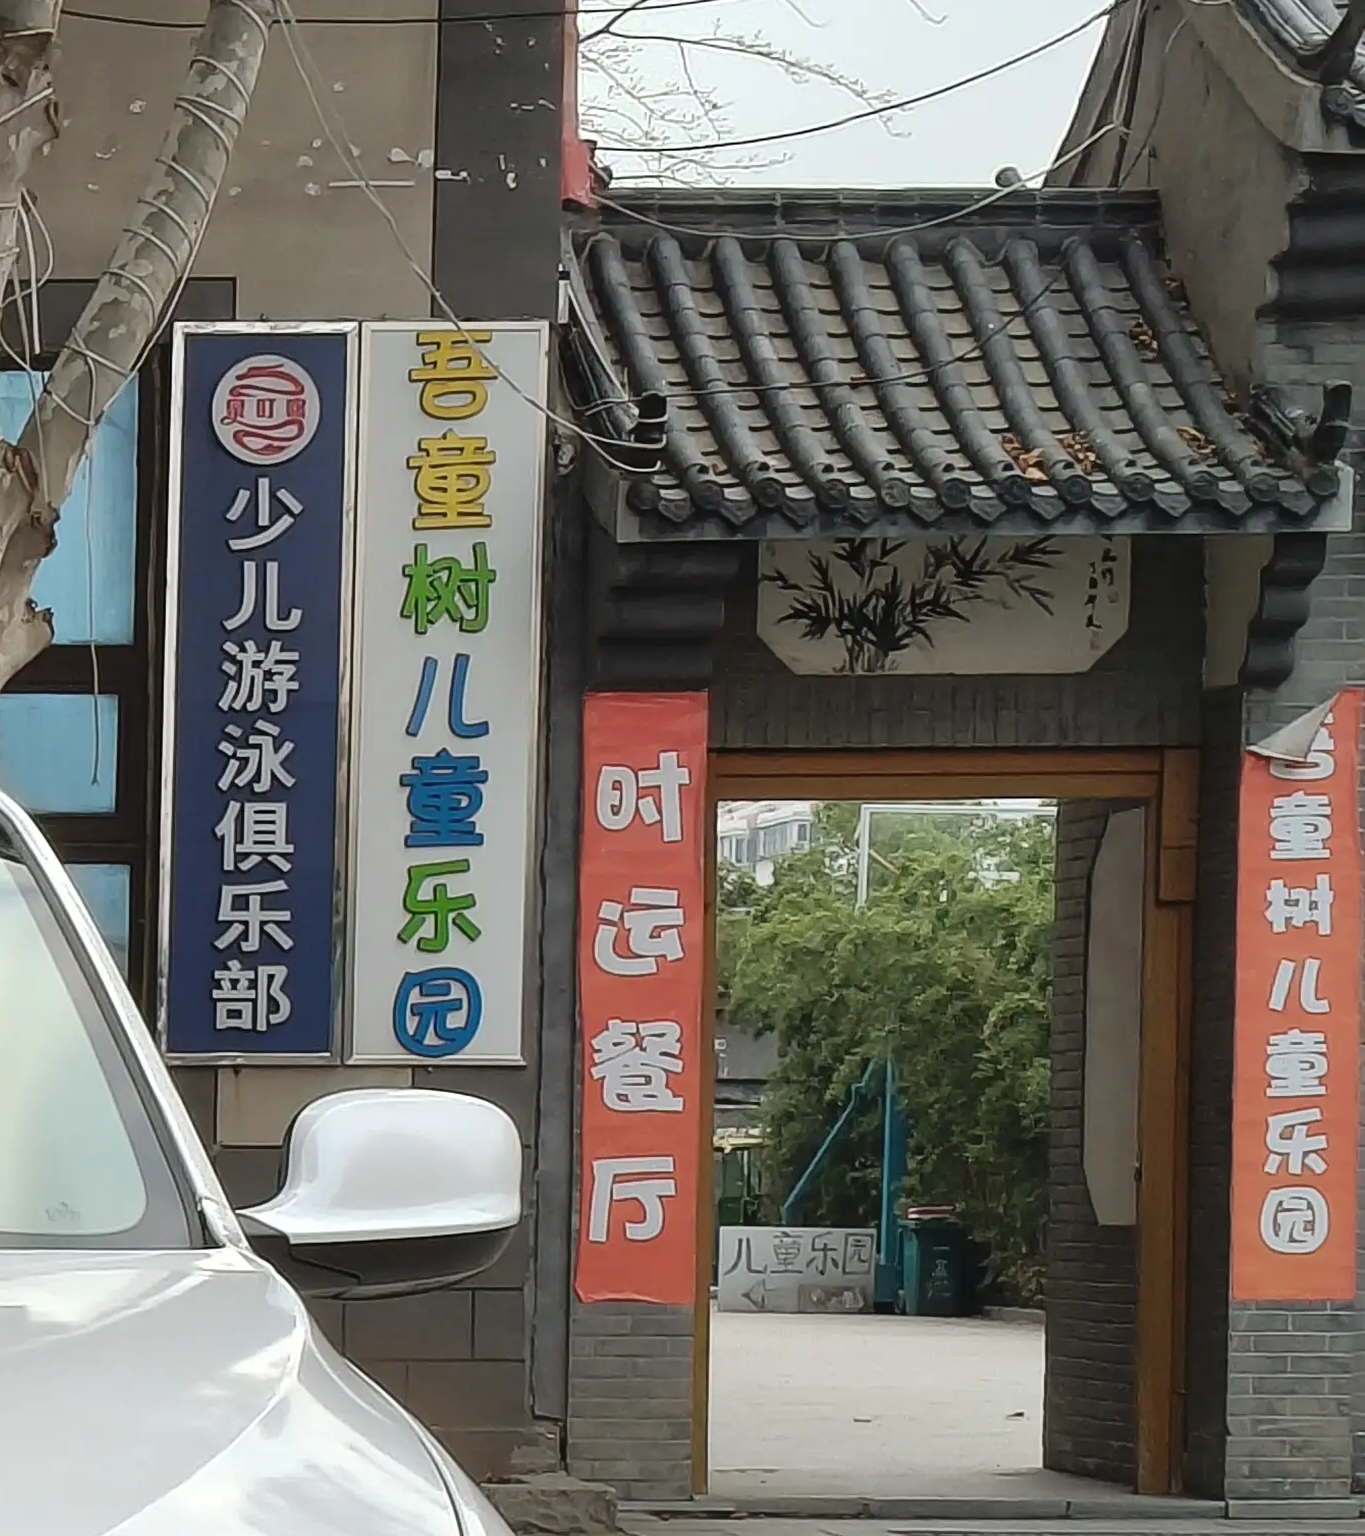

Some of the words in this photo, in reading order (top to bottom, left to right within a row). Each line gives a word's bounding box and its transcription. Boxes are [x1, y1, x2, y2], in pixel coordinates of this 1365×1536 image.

[211, 476, 304, 1033] 少儿游泳俱乐部
[392, 331, 499, 1058] 吾童树儿童乐园
[587, 750, 691, 1244] 时运餐厅
[723, 1230, 875, 1276] 儿童乐园
